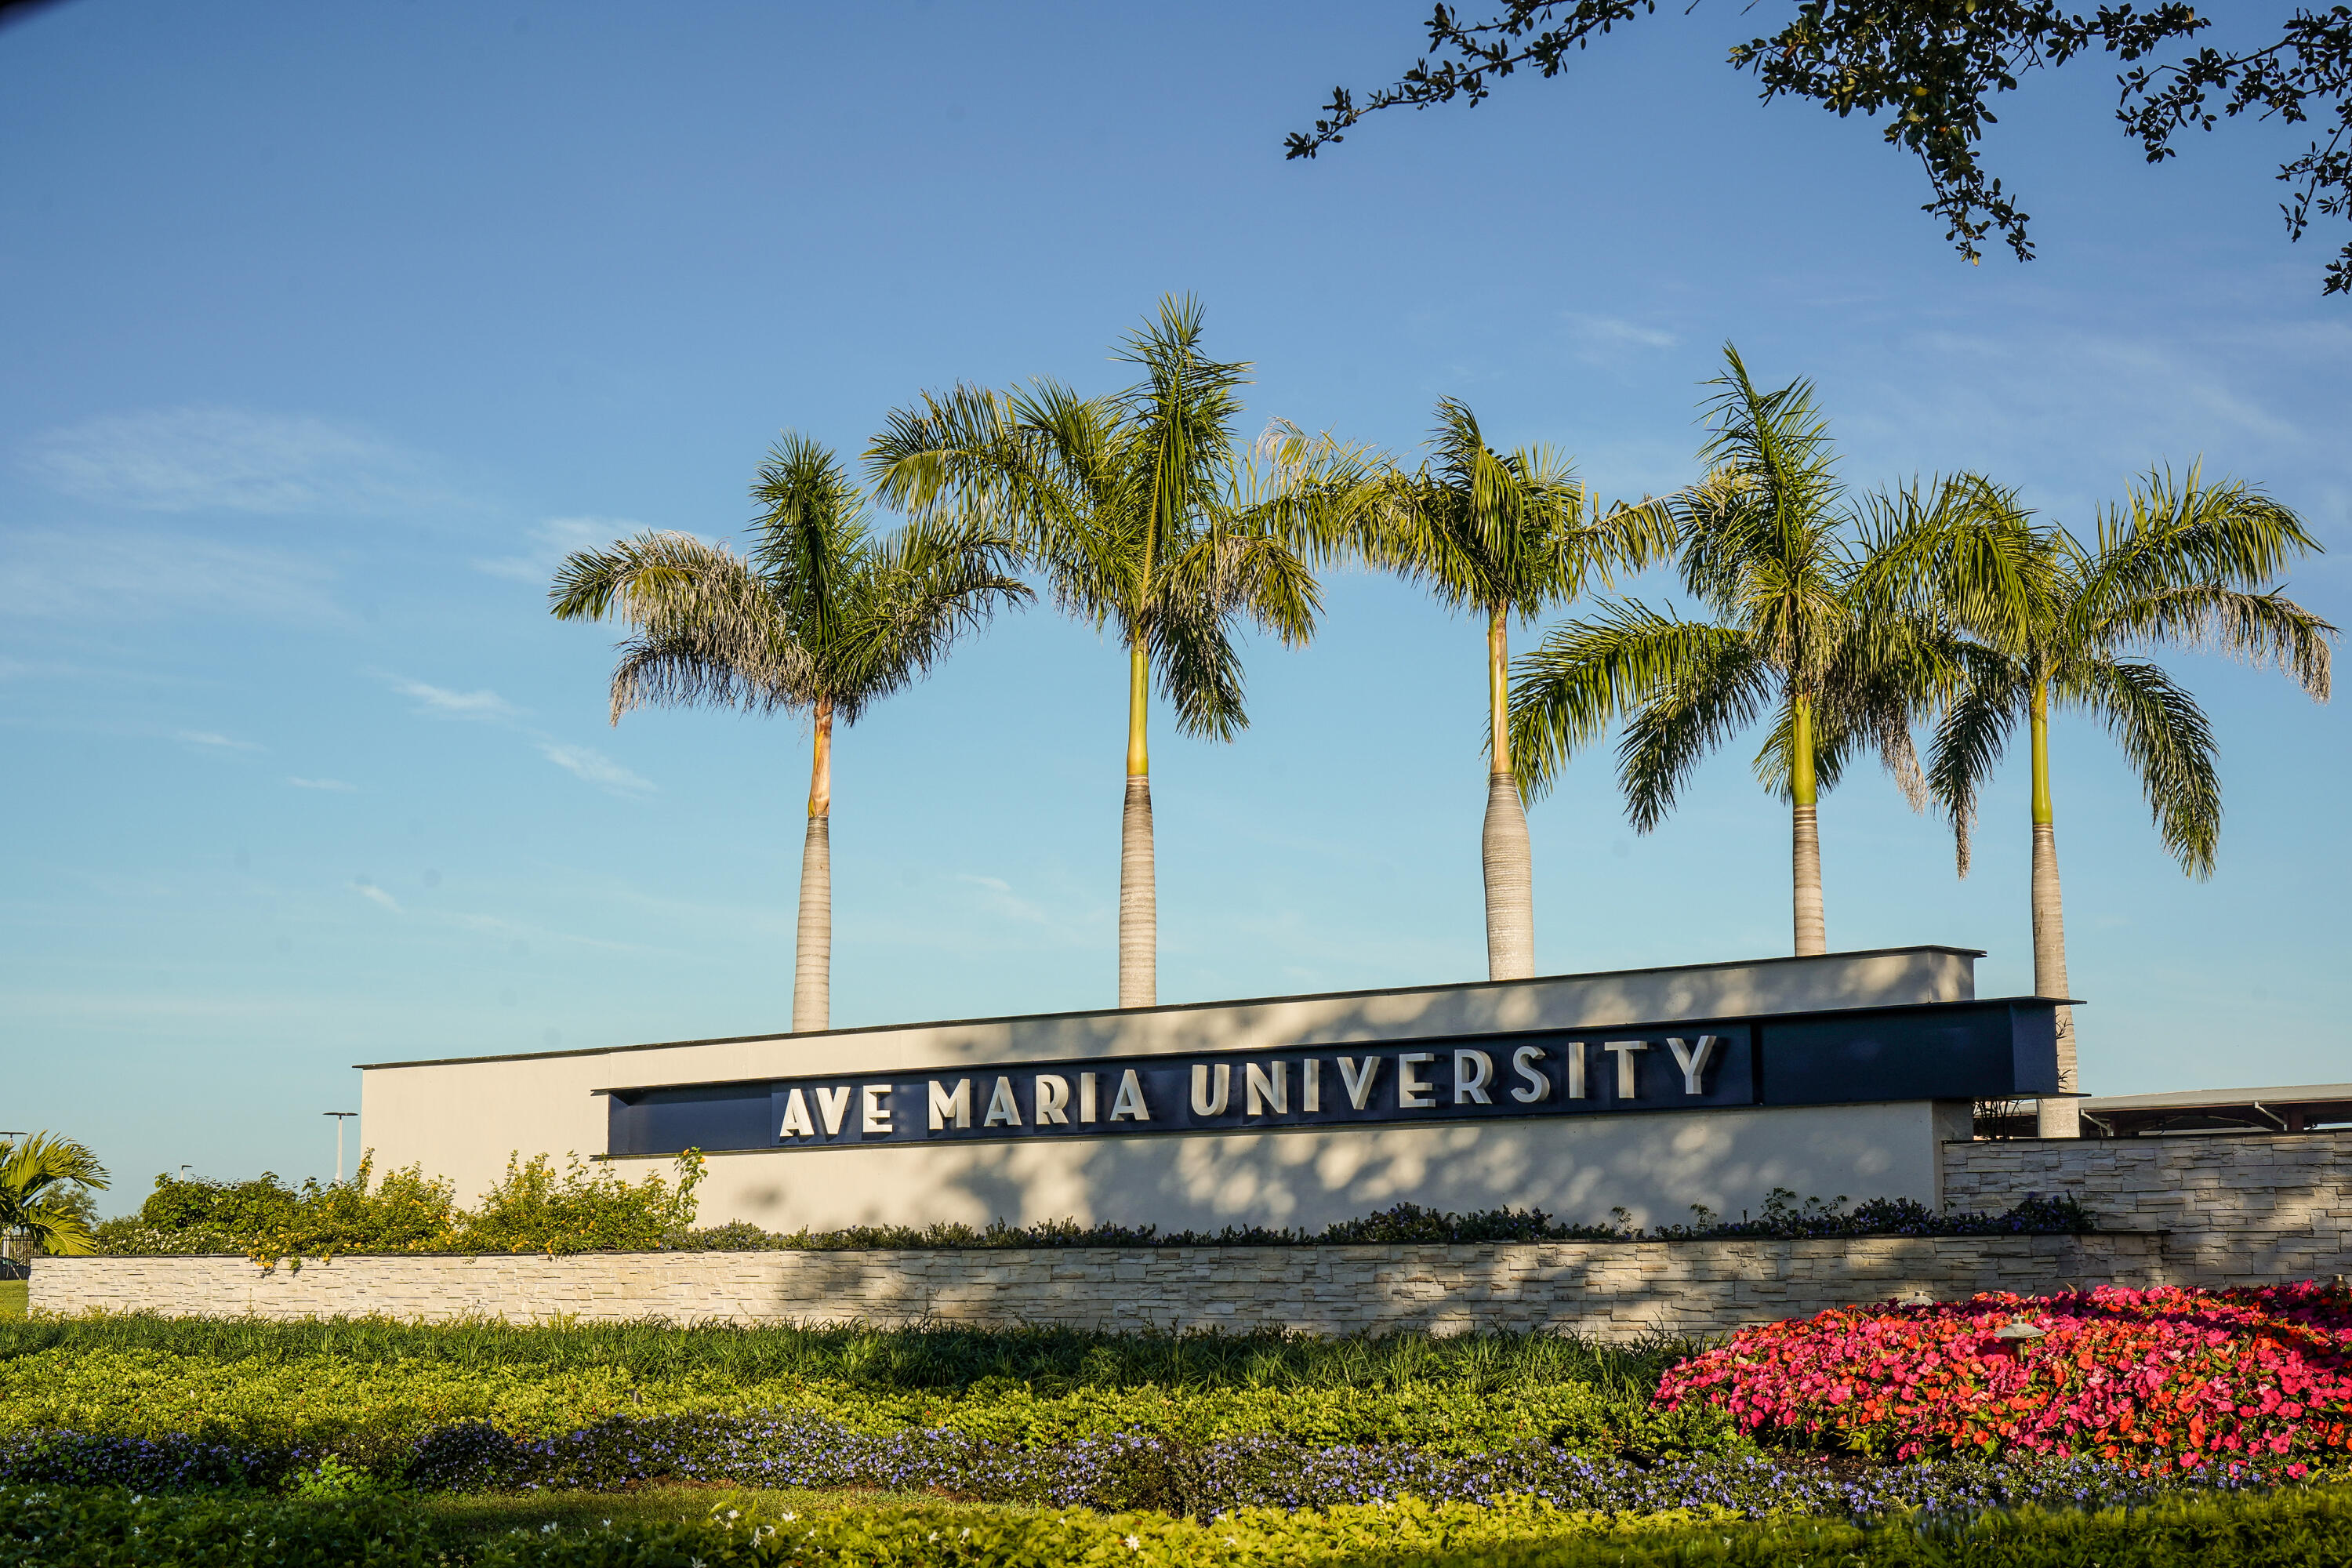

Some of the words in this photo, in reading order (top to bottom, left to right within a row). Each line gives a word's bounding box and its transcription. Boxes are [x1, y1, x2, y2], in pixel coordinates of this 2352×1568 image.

[779, 1083, 893, 1137] AVE
[928, 1069, 1150, 1130] MARIA
[1190, 1035, 1717, 1116] UNIVERSITY
